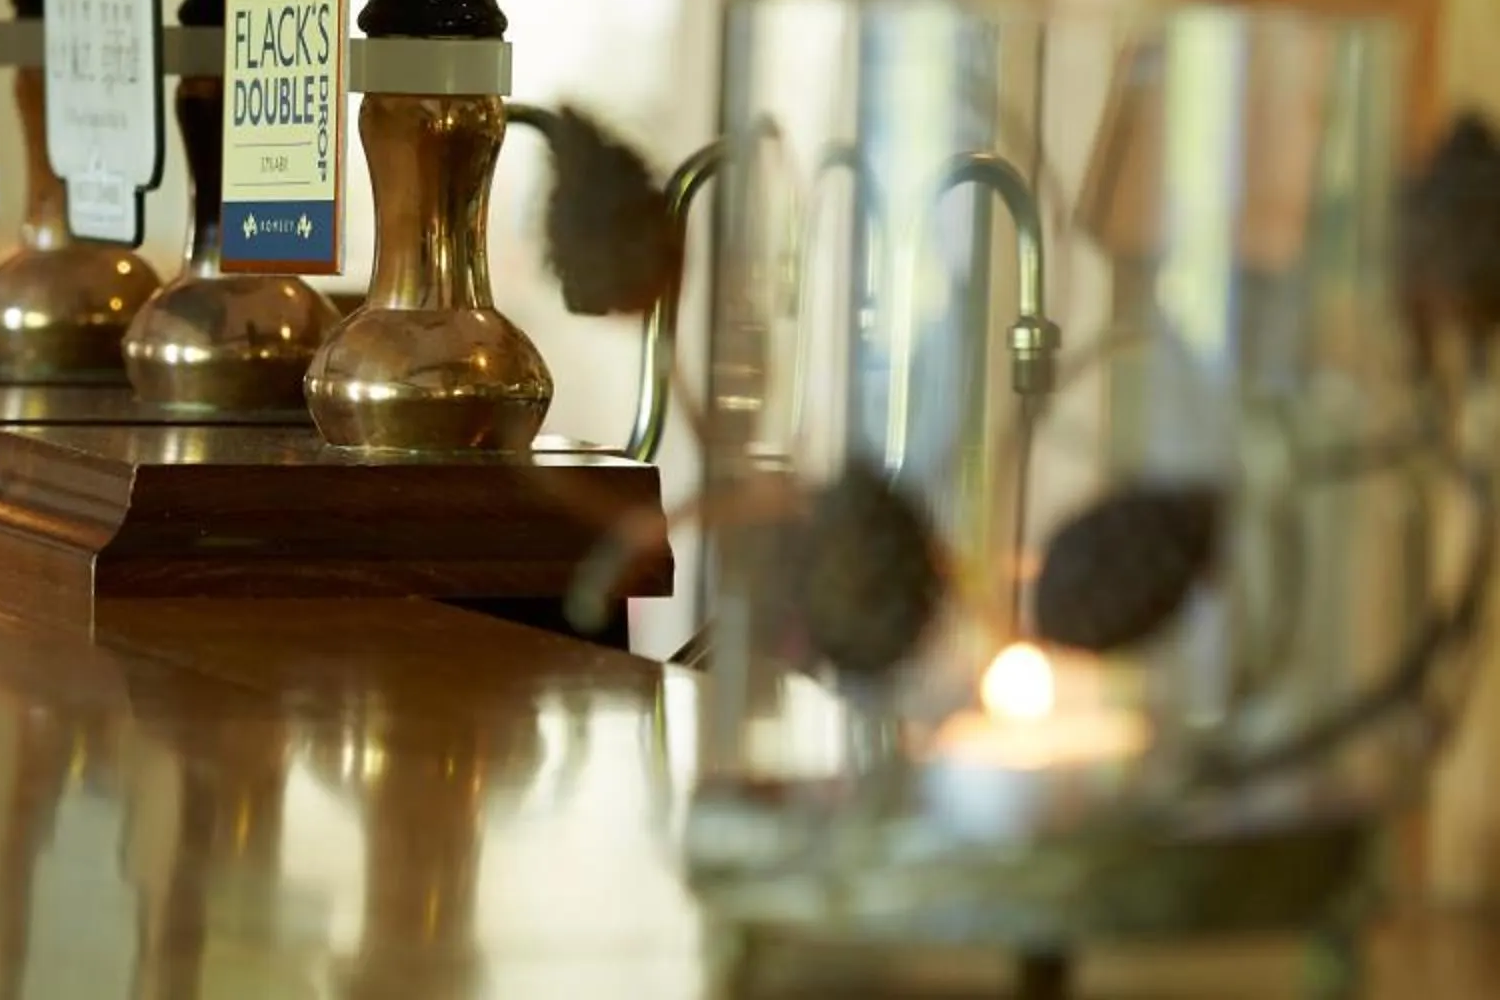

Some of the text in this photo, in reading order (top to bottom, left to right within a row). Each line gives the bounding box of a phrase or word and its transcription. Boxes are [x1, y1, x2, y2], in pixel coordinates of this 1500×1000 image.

[235, 3, 329, 69] FLACK'S
[234, 76, 314, 126] DOUBLE
[318, 76, 329, 182] DROP
